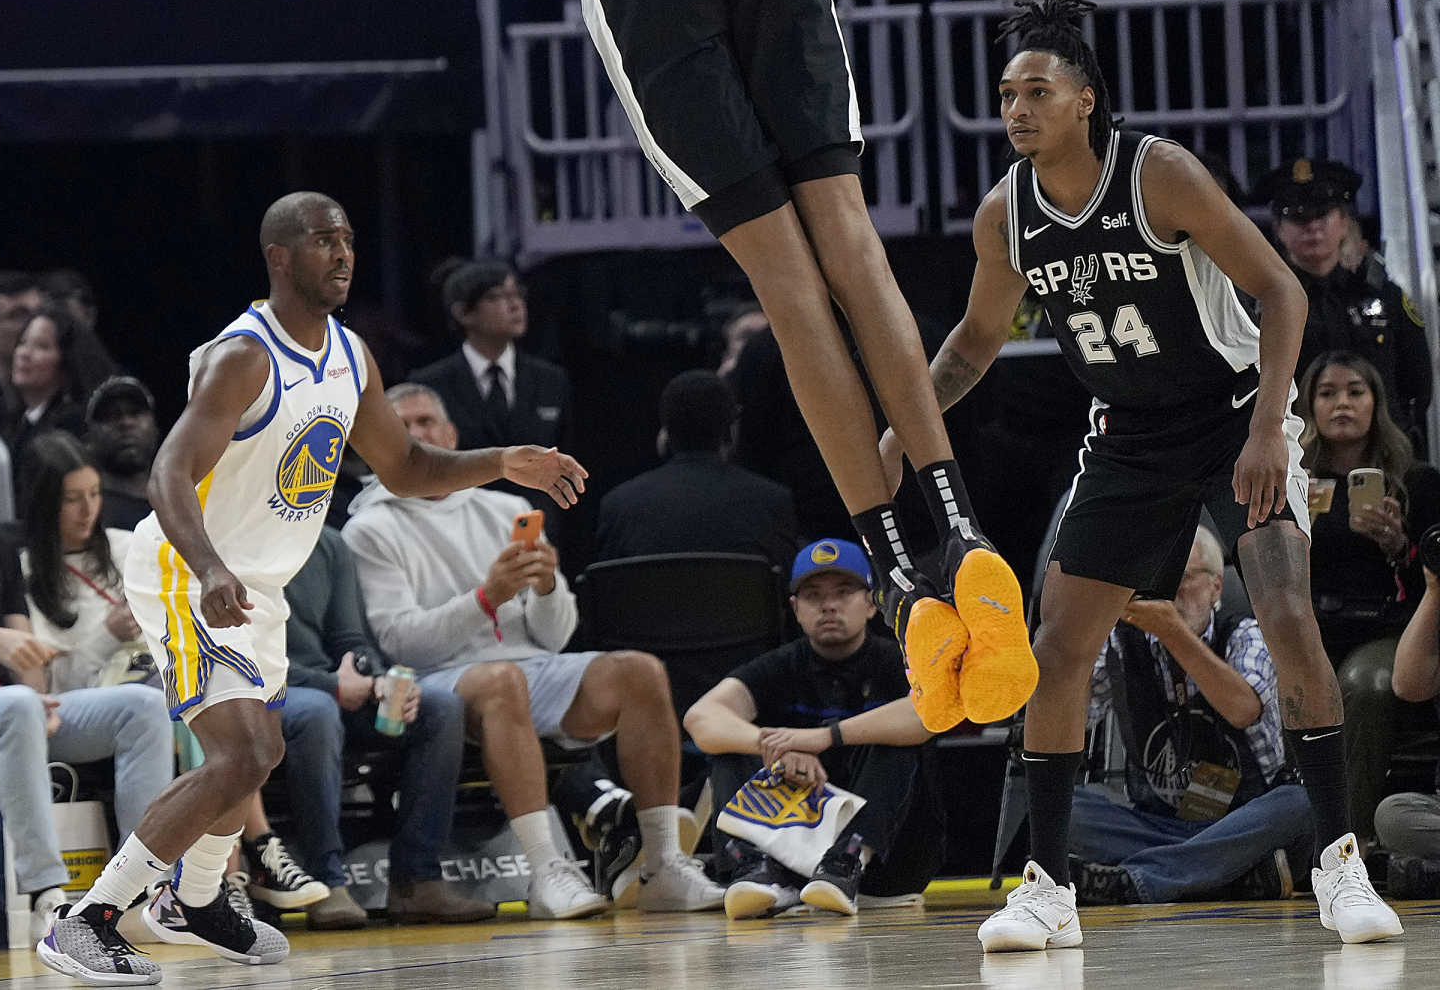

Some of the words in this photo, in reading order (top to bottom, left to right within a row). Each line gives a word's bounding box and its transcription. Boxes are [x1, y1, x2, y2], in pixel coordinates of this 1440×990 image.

[1101, 212, 1131, 230] Self.
[1067, 303, 1161, 364] 24
[286, 405, 322, 441] GOLDEN
[325, 437, 340, 463] 3
